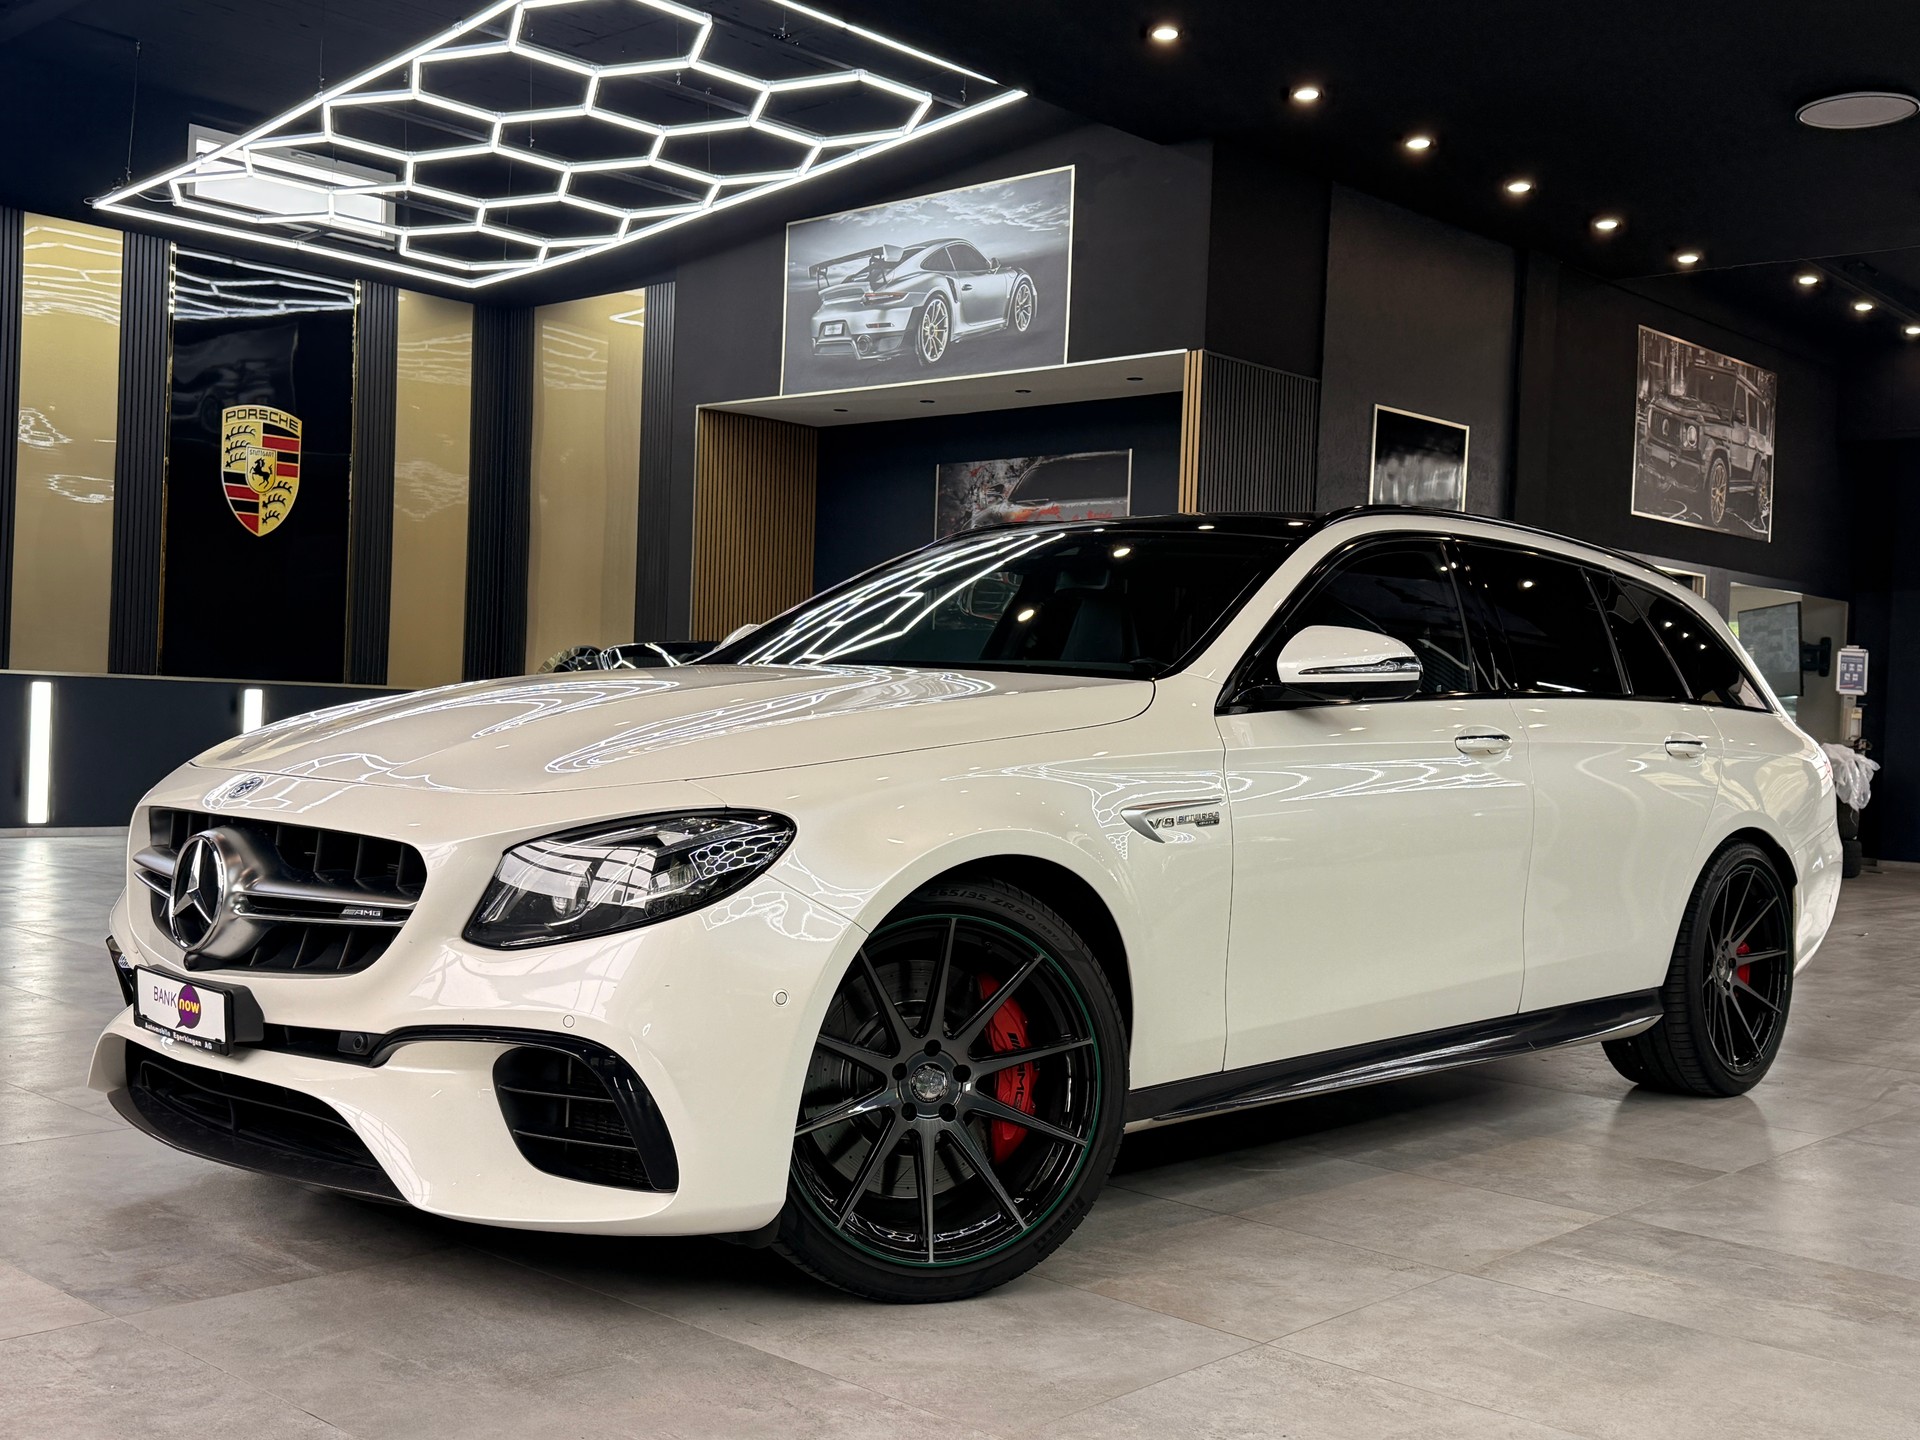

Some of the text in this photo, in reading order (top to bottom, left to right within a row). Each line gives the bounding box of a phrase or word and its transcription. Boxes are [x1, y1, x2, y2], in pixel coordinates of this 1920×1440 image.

[226, 408, 298, 433] PORSCHE
[1147, 817, 1175, 830] V8
[354, 909, 381, 917] AMG
[927, 888, 988, 901] 265/35
[990, 897, 1036, 921] ZR20
[153, 986, 199, 1014] BANK now
[204, 1041, 213, 1050] AG
